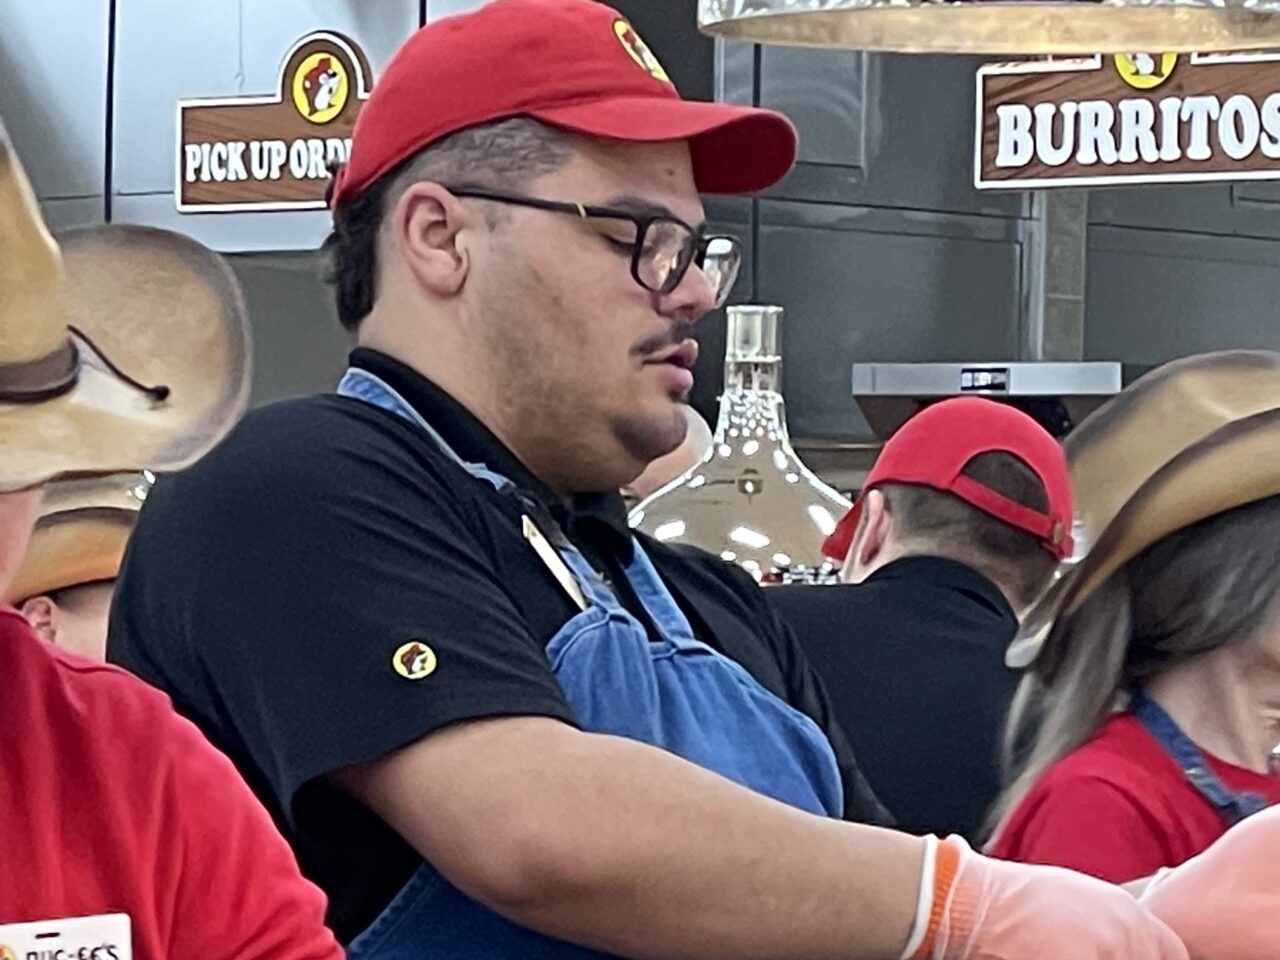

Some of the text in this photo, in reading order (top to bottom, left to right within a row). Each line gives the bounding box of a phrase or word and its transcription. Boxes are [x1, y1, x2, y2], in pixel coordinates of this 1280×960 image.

[184, 137, 353, 183] PICK UP ORD
